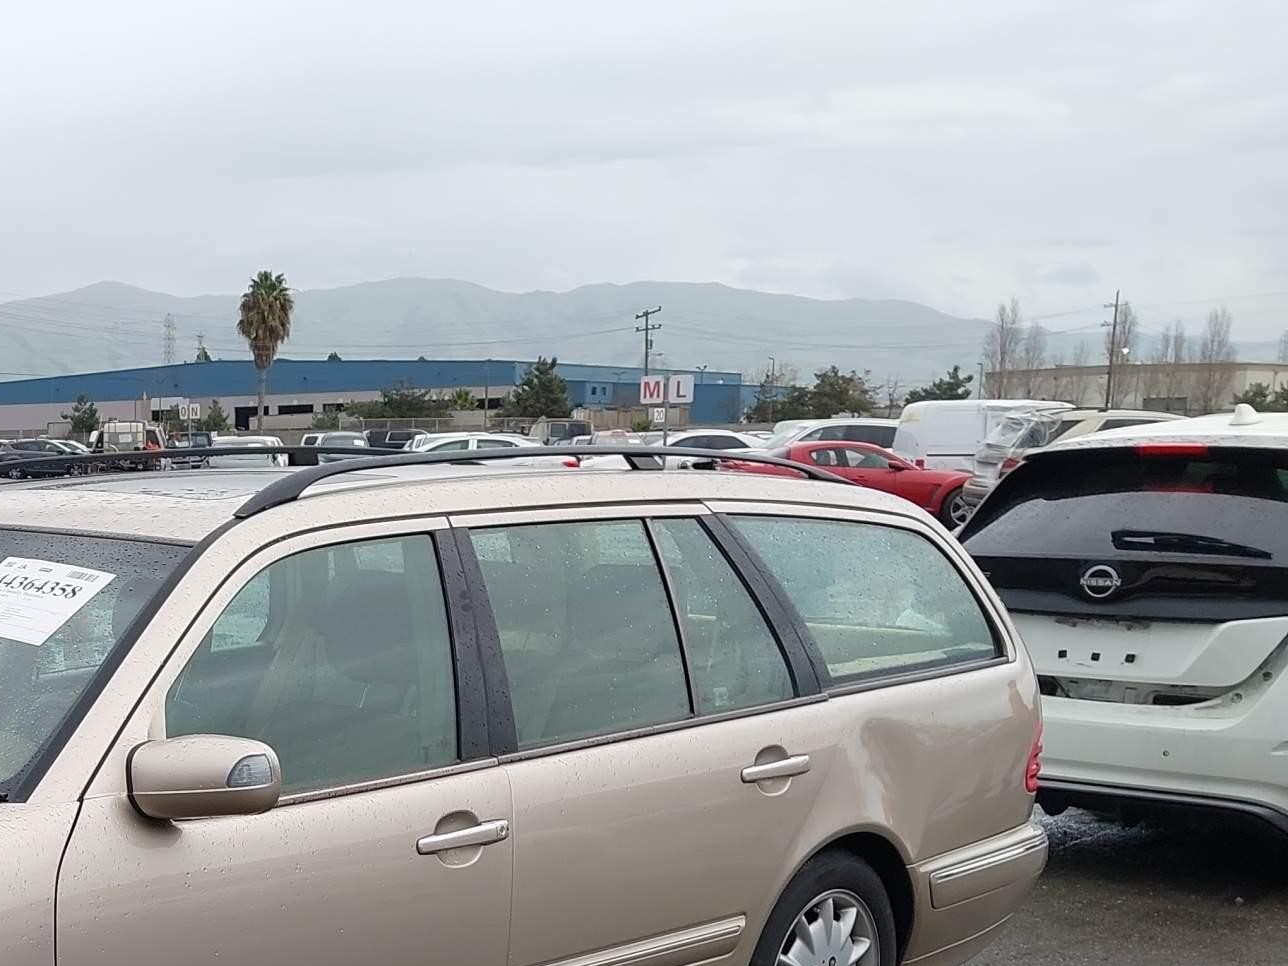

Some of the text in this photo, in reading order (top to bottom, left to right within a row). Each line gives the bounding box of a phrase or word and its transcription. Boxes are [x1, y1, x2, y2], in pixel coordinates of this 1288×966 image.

[643, 380, 687, 399] M L
[655, 409, 664, 421] 20
[1080, 577, 1122, 587] NISSAN
